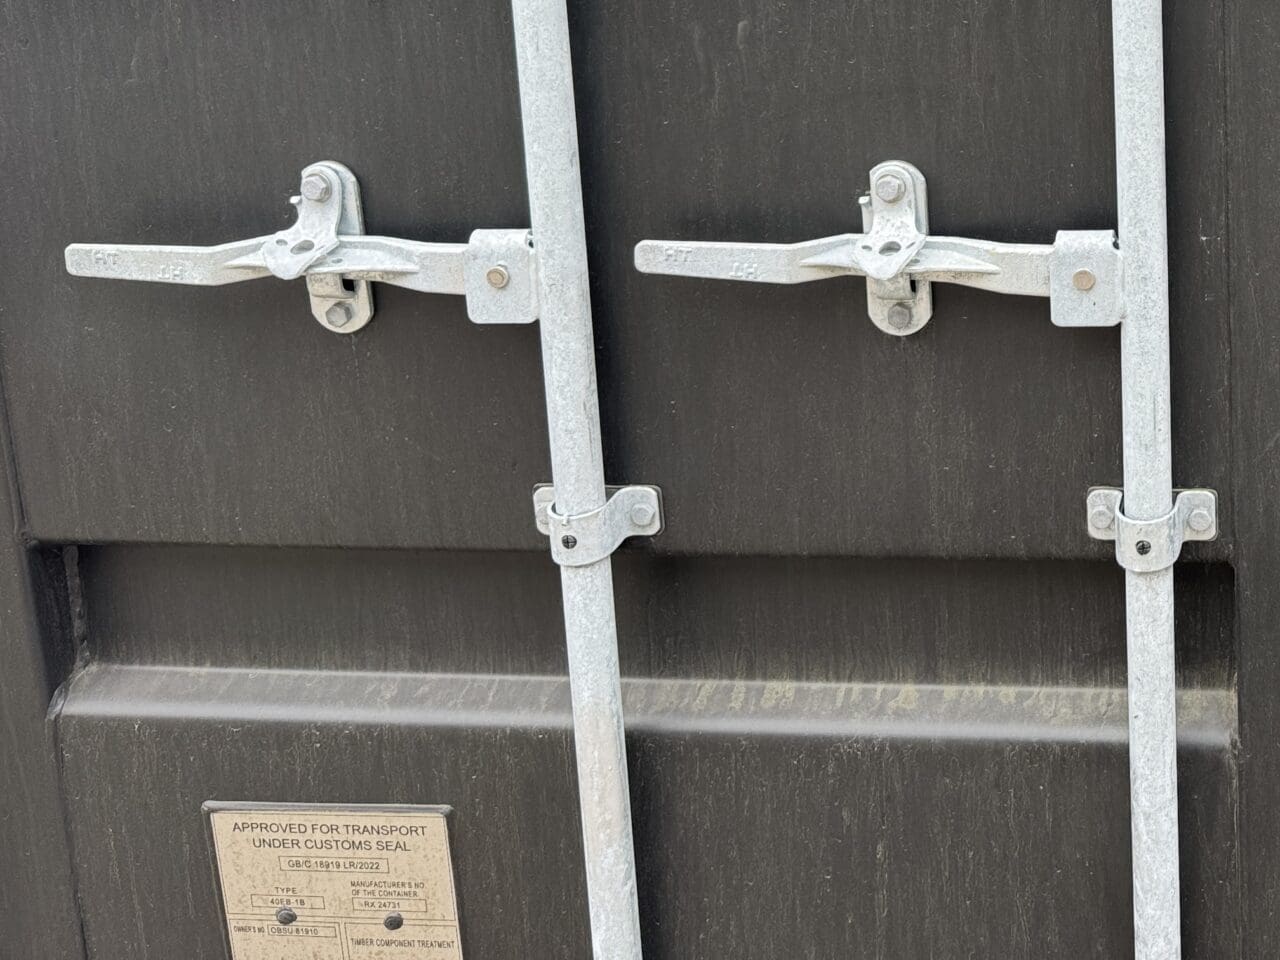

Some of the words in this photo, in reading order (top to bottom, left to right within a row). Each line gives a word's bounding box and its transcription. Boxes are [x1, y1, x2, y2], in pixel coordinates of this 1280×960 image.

[232, 822, 307, 835] APPROVED
[311, 823, 340, 835] FOR
[343, 824, 427, 836] TRANSPORT
[252, 838, 300, 849] UNDER
[304, 839, 372, 851] CUSTOMS
[376, 840, 411, 852] SEAL
[287, 859, 311, 869] GB/C
[343, 860, 380, 871] LR/2022
[275, 886, 298, 894] TYPE
[350, 938, 375, 946] TIMBER
[376, 939, 415, 948] COMPONENT
[416, 940, 455, 949] TREATMENT
